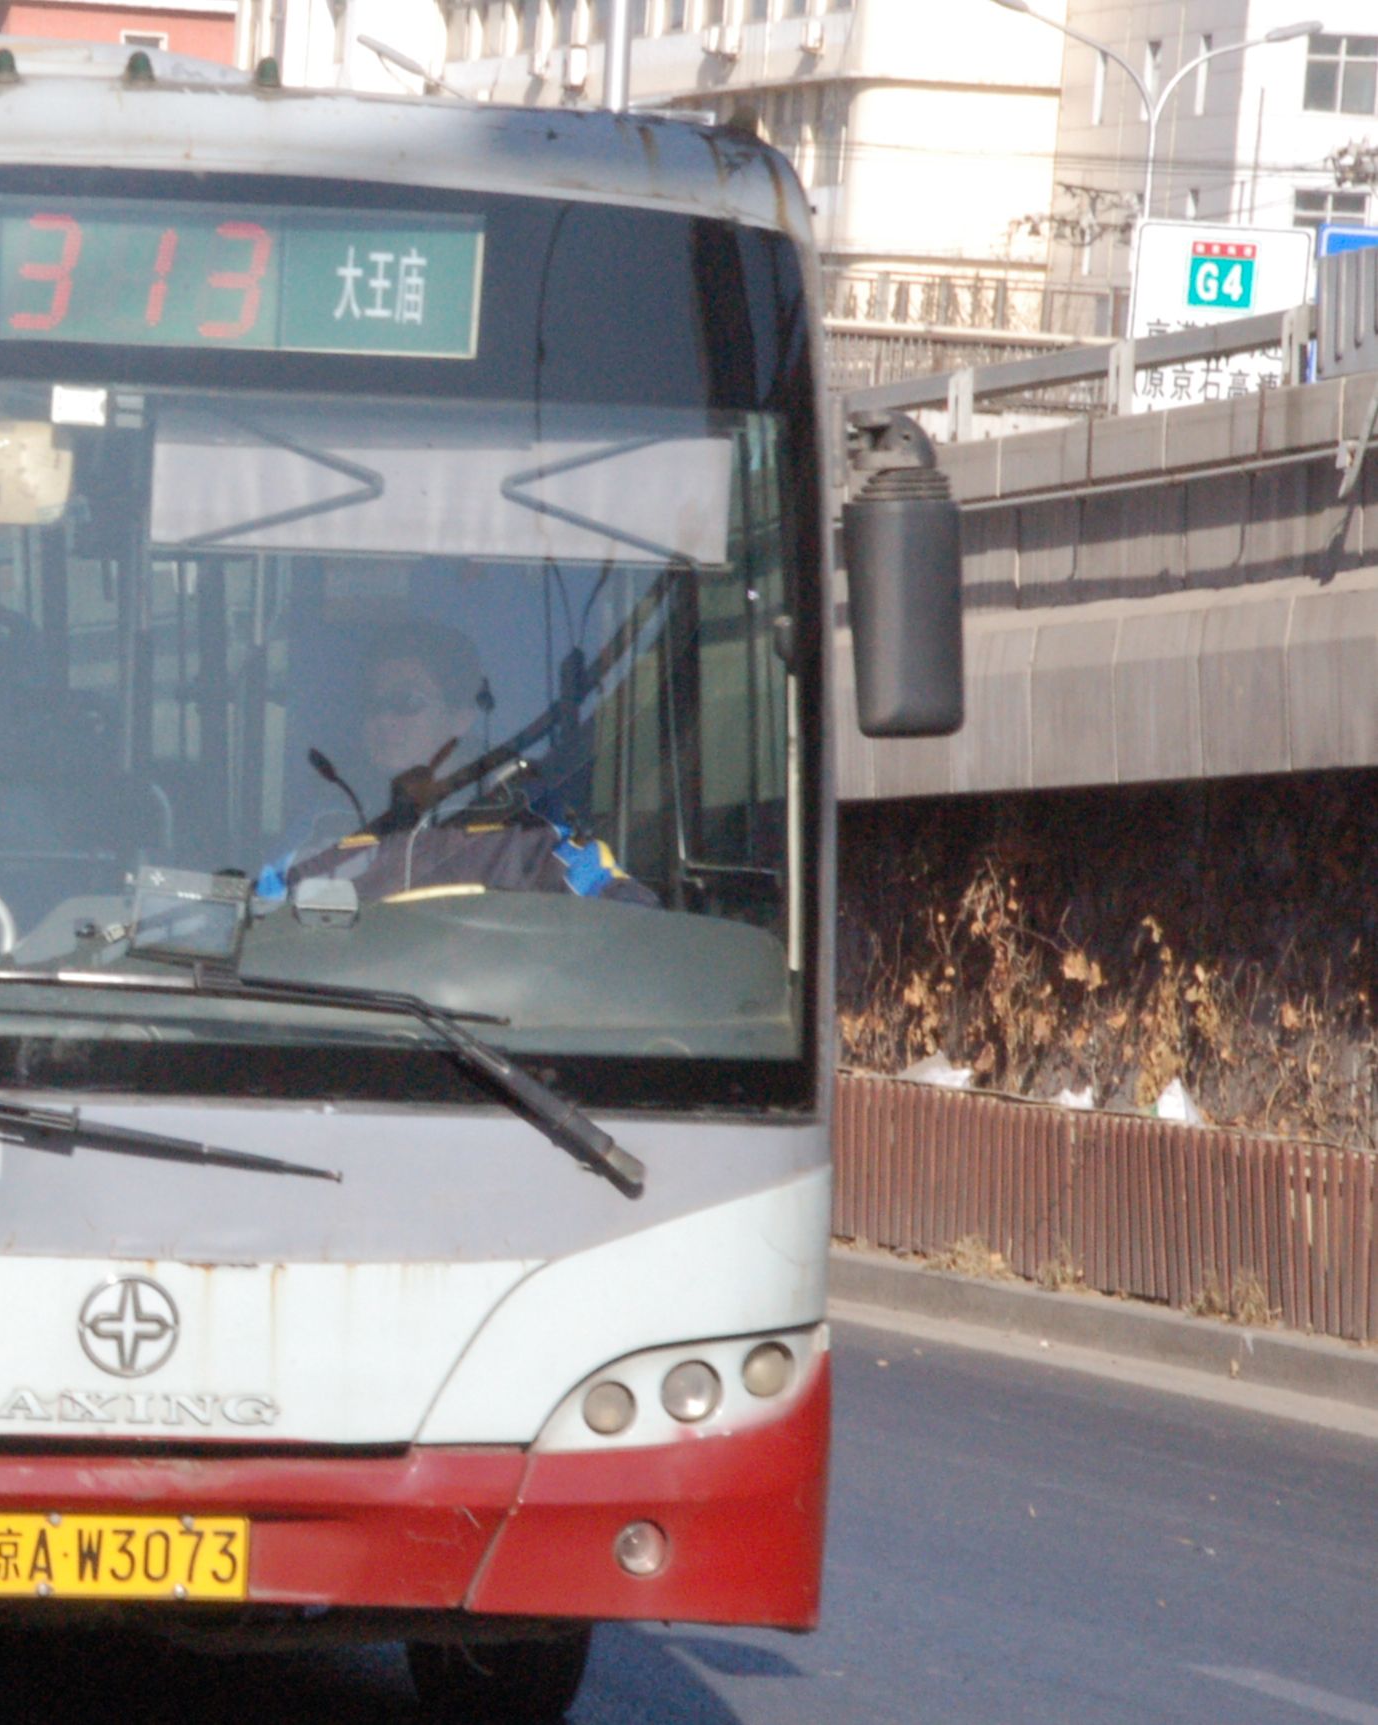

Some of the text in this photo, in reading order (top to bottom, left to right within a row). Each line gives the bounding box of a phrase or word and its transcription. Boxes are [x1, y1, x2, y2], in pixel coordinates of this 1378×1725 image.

[9, 212, 273, 340] 313
[333, 245, 428, 325] 大王庙
[1195, 261, 1244, 302] G4
